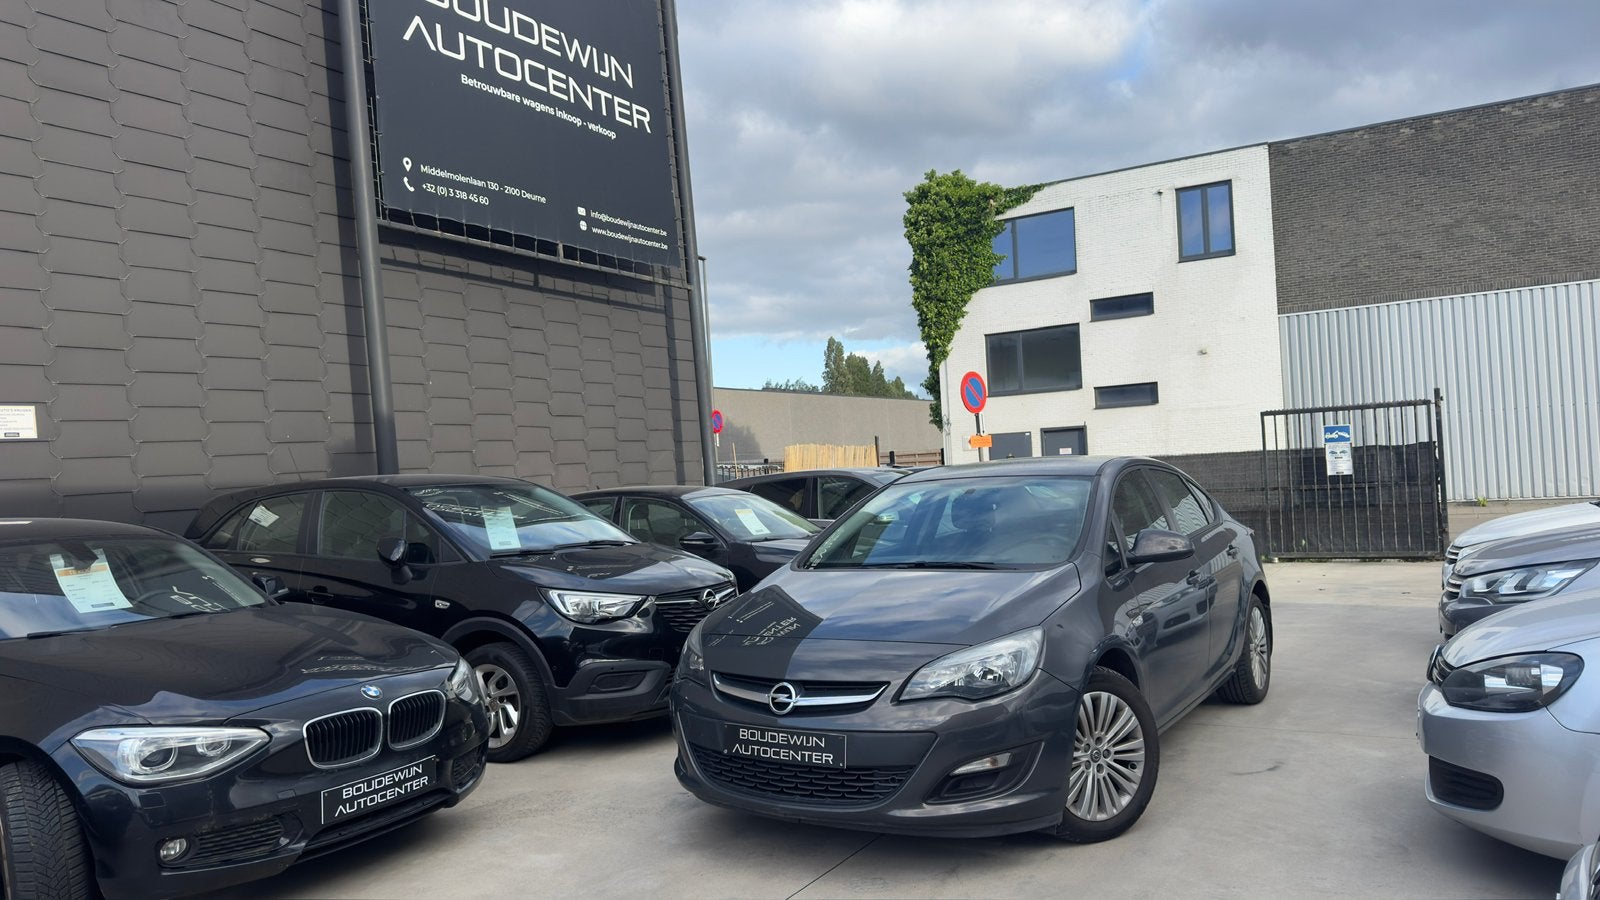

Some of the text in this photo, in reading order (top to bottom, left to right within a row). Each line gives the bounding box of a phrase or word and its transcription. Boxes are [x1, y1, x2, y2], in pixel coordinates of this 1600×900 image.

[425, 0, 634, 89] OUDEWIJN
[402, 15, 652, 133] AUTOCENTER
[460, 74, 521, 103] Betrouwbare
[522, 96, 555, 116] wagens
[555, 107, 583, 128] inkoop
[587, 121, 617, 140] verkoop
[420, 164, 487, 188] Middelmolenlaan
[488, 181, 500, 192] 130
[504, 185, 521, 197] 2100
[521, 189, 546, 203] Deurne
[422, 183, 490, 206] +32 (0) 3 318 45 60
[732, 743, 834, 765] AUTOCENTER
[739, 728, 825, 748] BOUDEWIJN
[334, 775, 429, 817] AUTOCENTER
[342, 763, 423, 799] BOUDEWIJN
